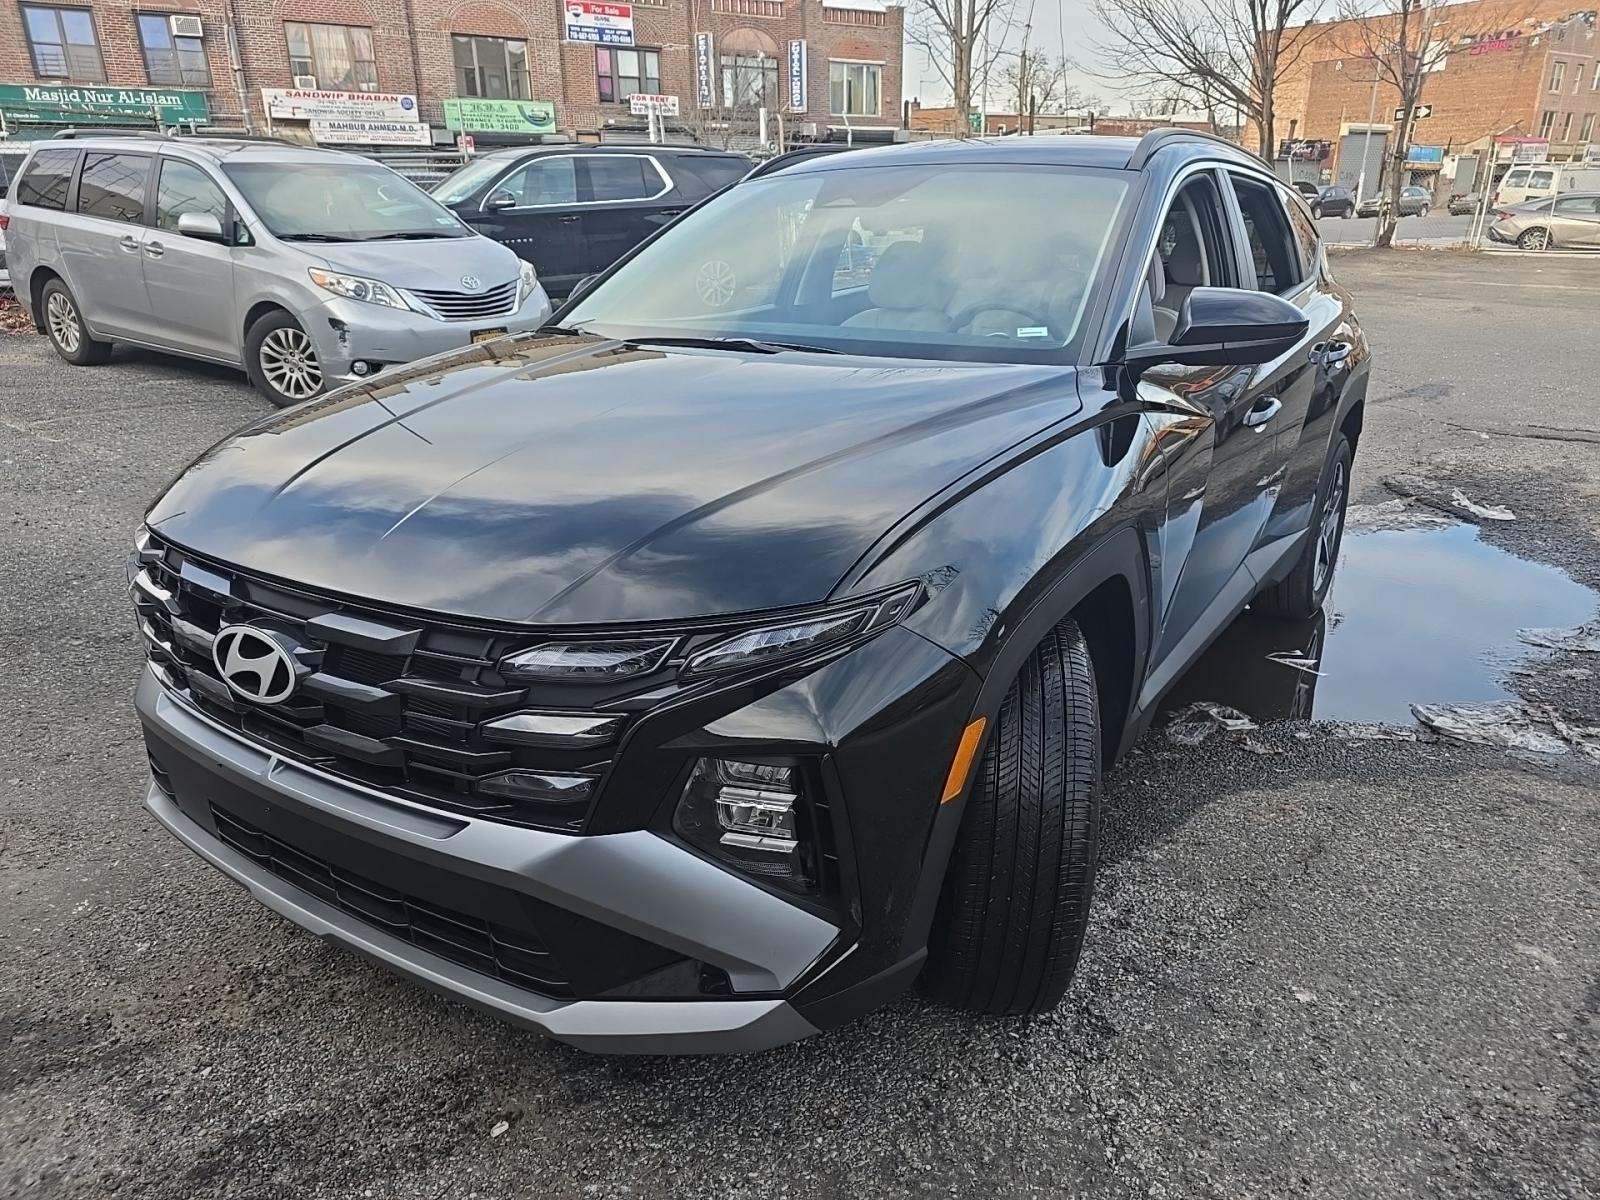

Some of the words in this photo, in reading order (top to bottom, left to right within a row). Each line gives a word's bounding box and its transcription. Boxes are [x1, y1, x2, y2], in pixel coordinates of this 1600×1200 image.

[591, 5, 603, 13] For
[605, 6, 620, 15] Sale
[23, 87, 81, 104] Masjid
[83, 90, 114, 103] Nur
[118, 91, 182, 105] Al-Islam
[285, 90, 344, 100] SANDWIP
[348, 94, 398, 103] BHABAN
[650, 95, 670, 103] RENT
[328, 122, 366, 131] MAHBUB
